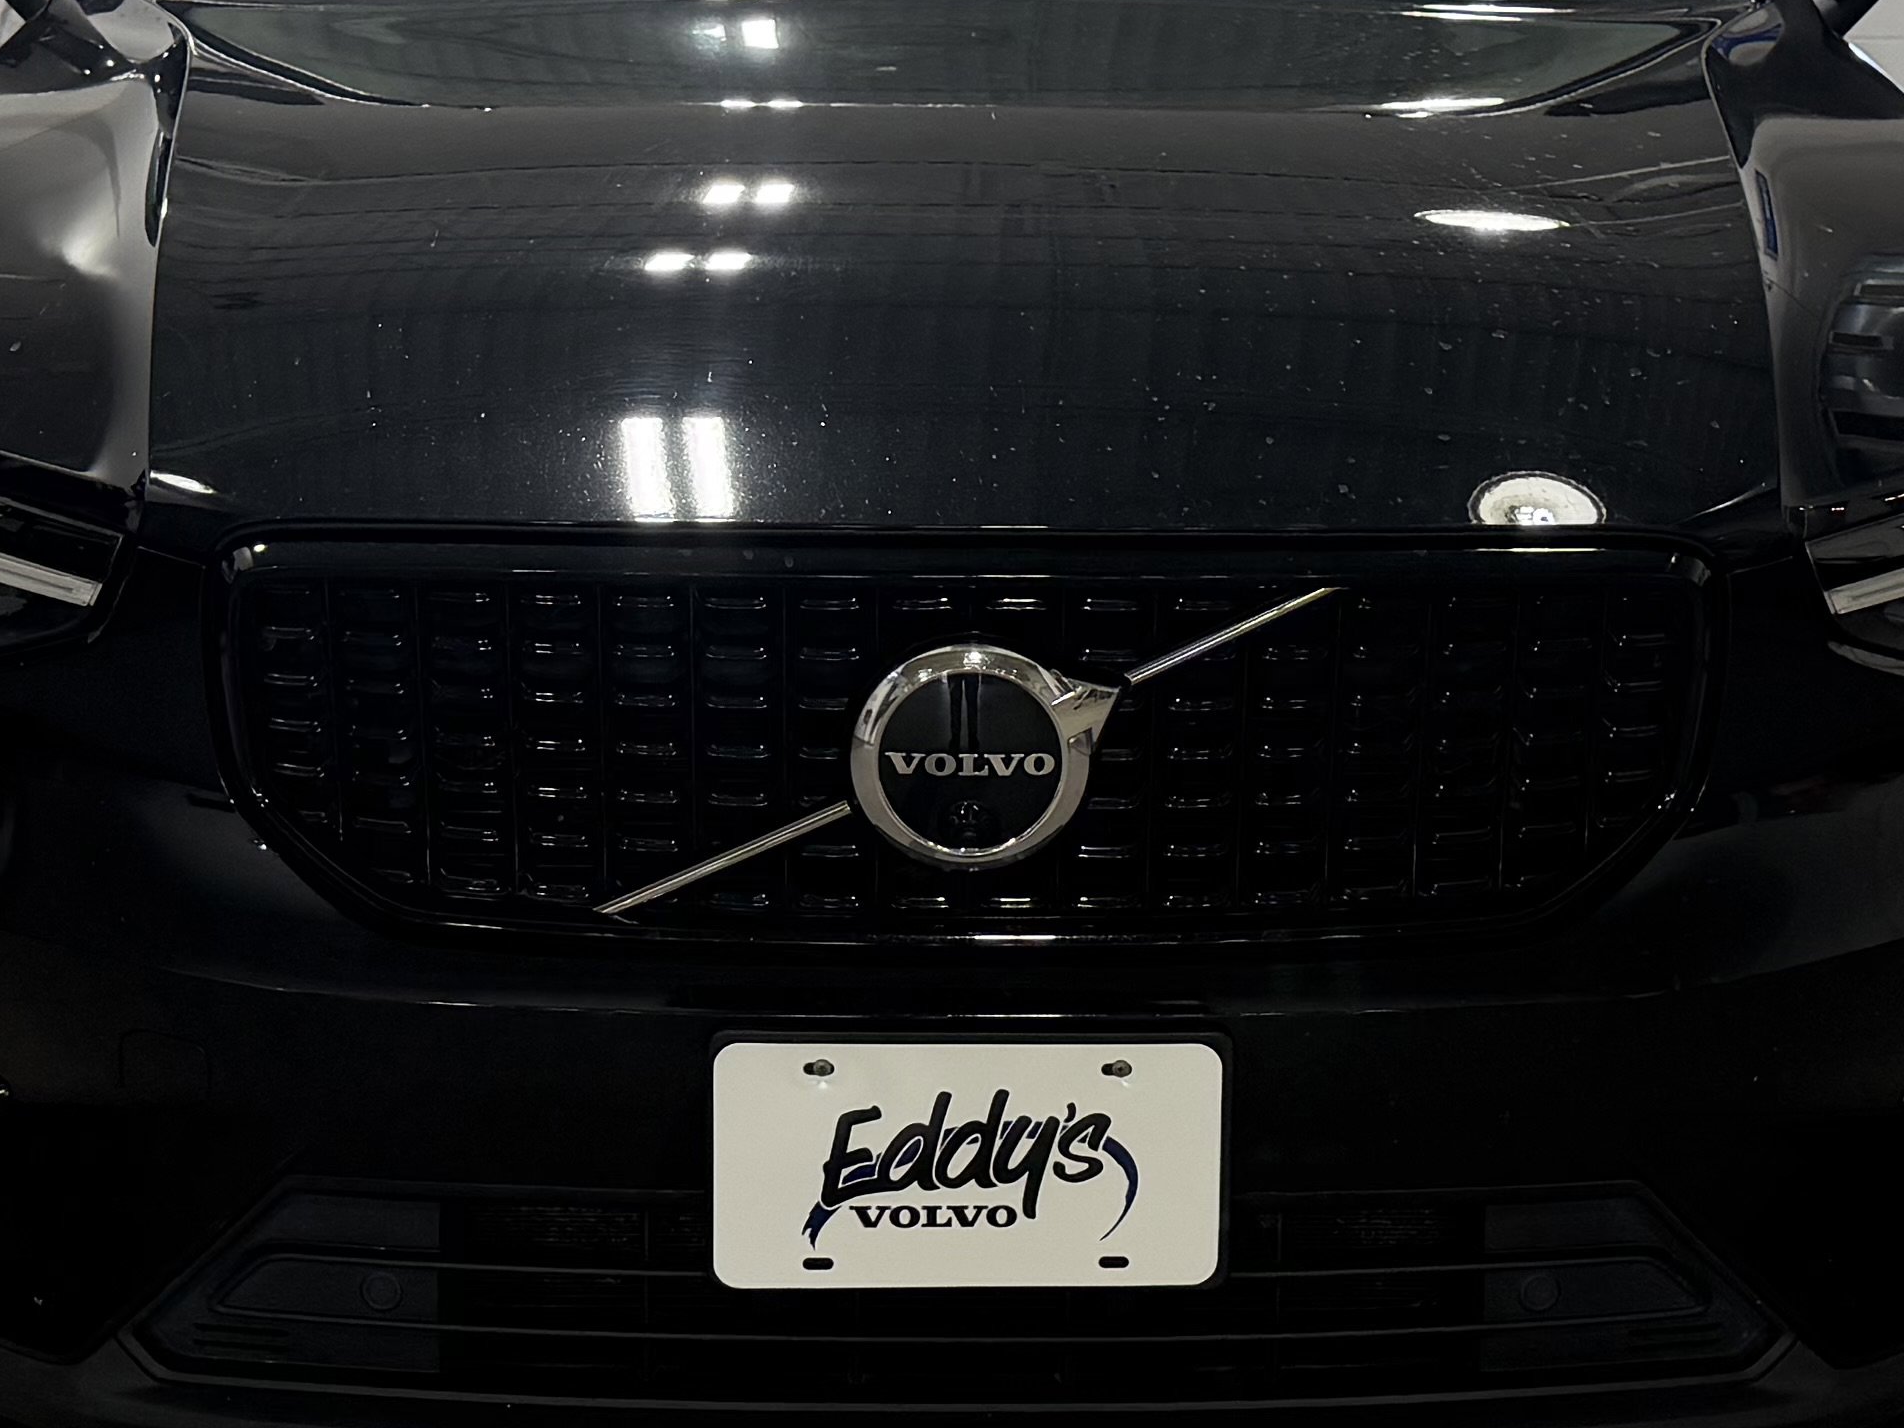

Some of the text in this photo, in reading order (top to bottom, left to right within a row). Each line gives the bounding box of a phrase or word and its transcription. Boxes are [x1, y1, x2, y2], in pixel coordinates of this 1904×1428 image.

[884, 751, 1056, 777] VOLVO
[821, 1088, 1112, 1220] Eddy's
[849, 1204, 1019, 1230] VOLVO
